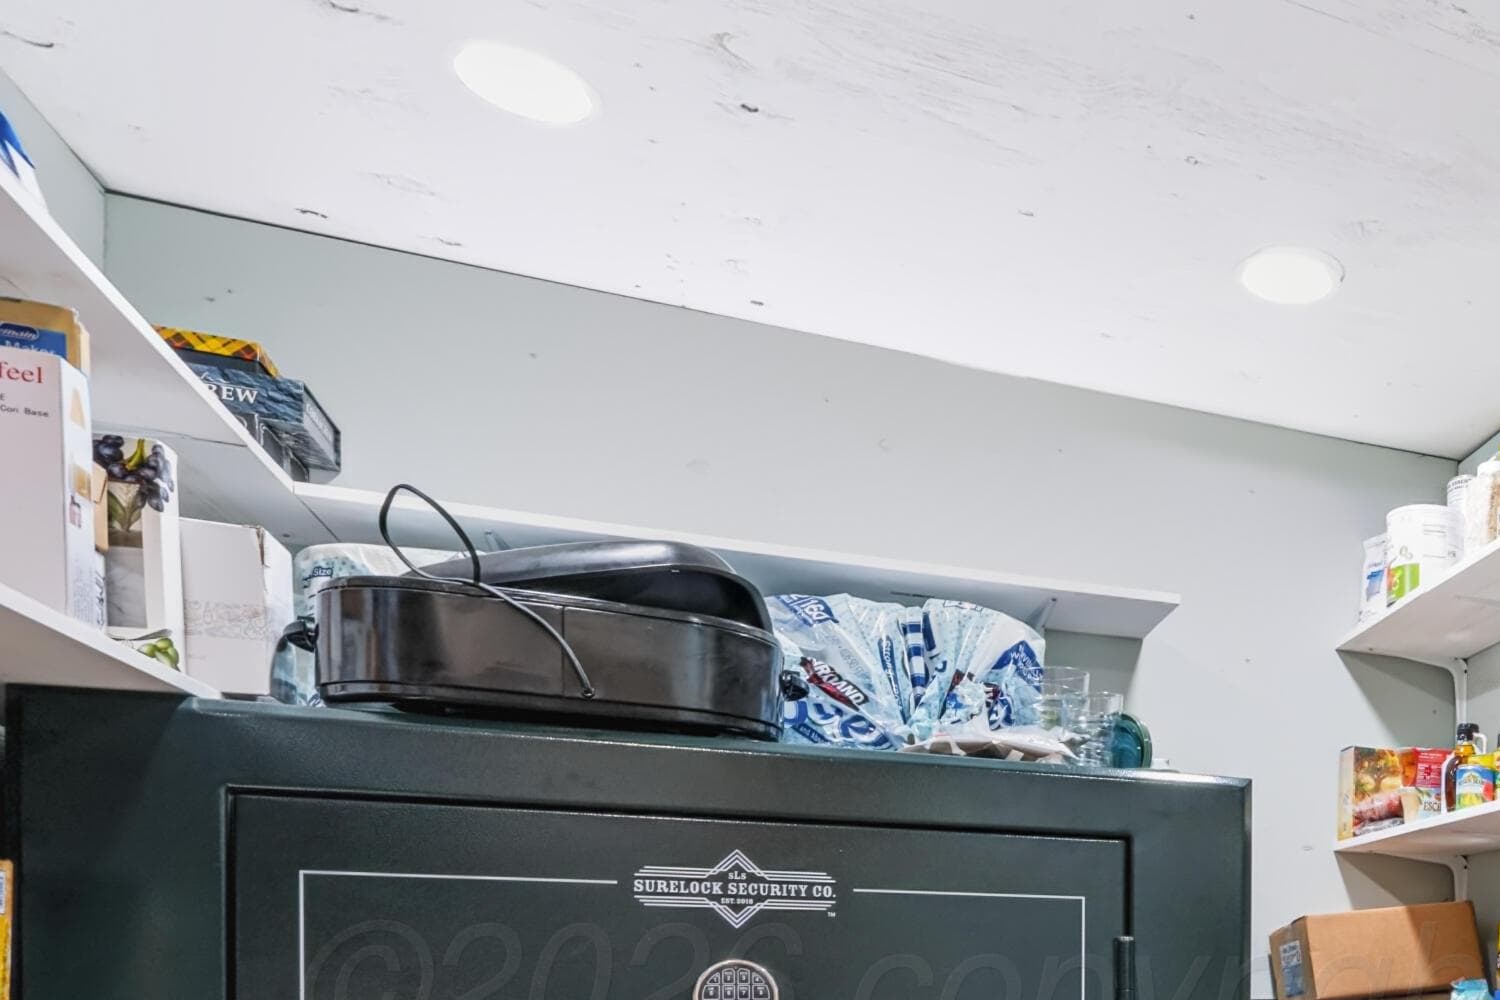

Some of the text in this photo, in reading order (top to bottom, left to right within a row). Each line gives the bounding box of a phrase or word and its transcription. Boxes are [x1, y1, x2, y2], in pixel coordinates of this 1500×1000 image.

[634, 880, 837, 898] SURELOCK SECURITY CO.
